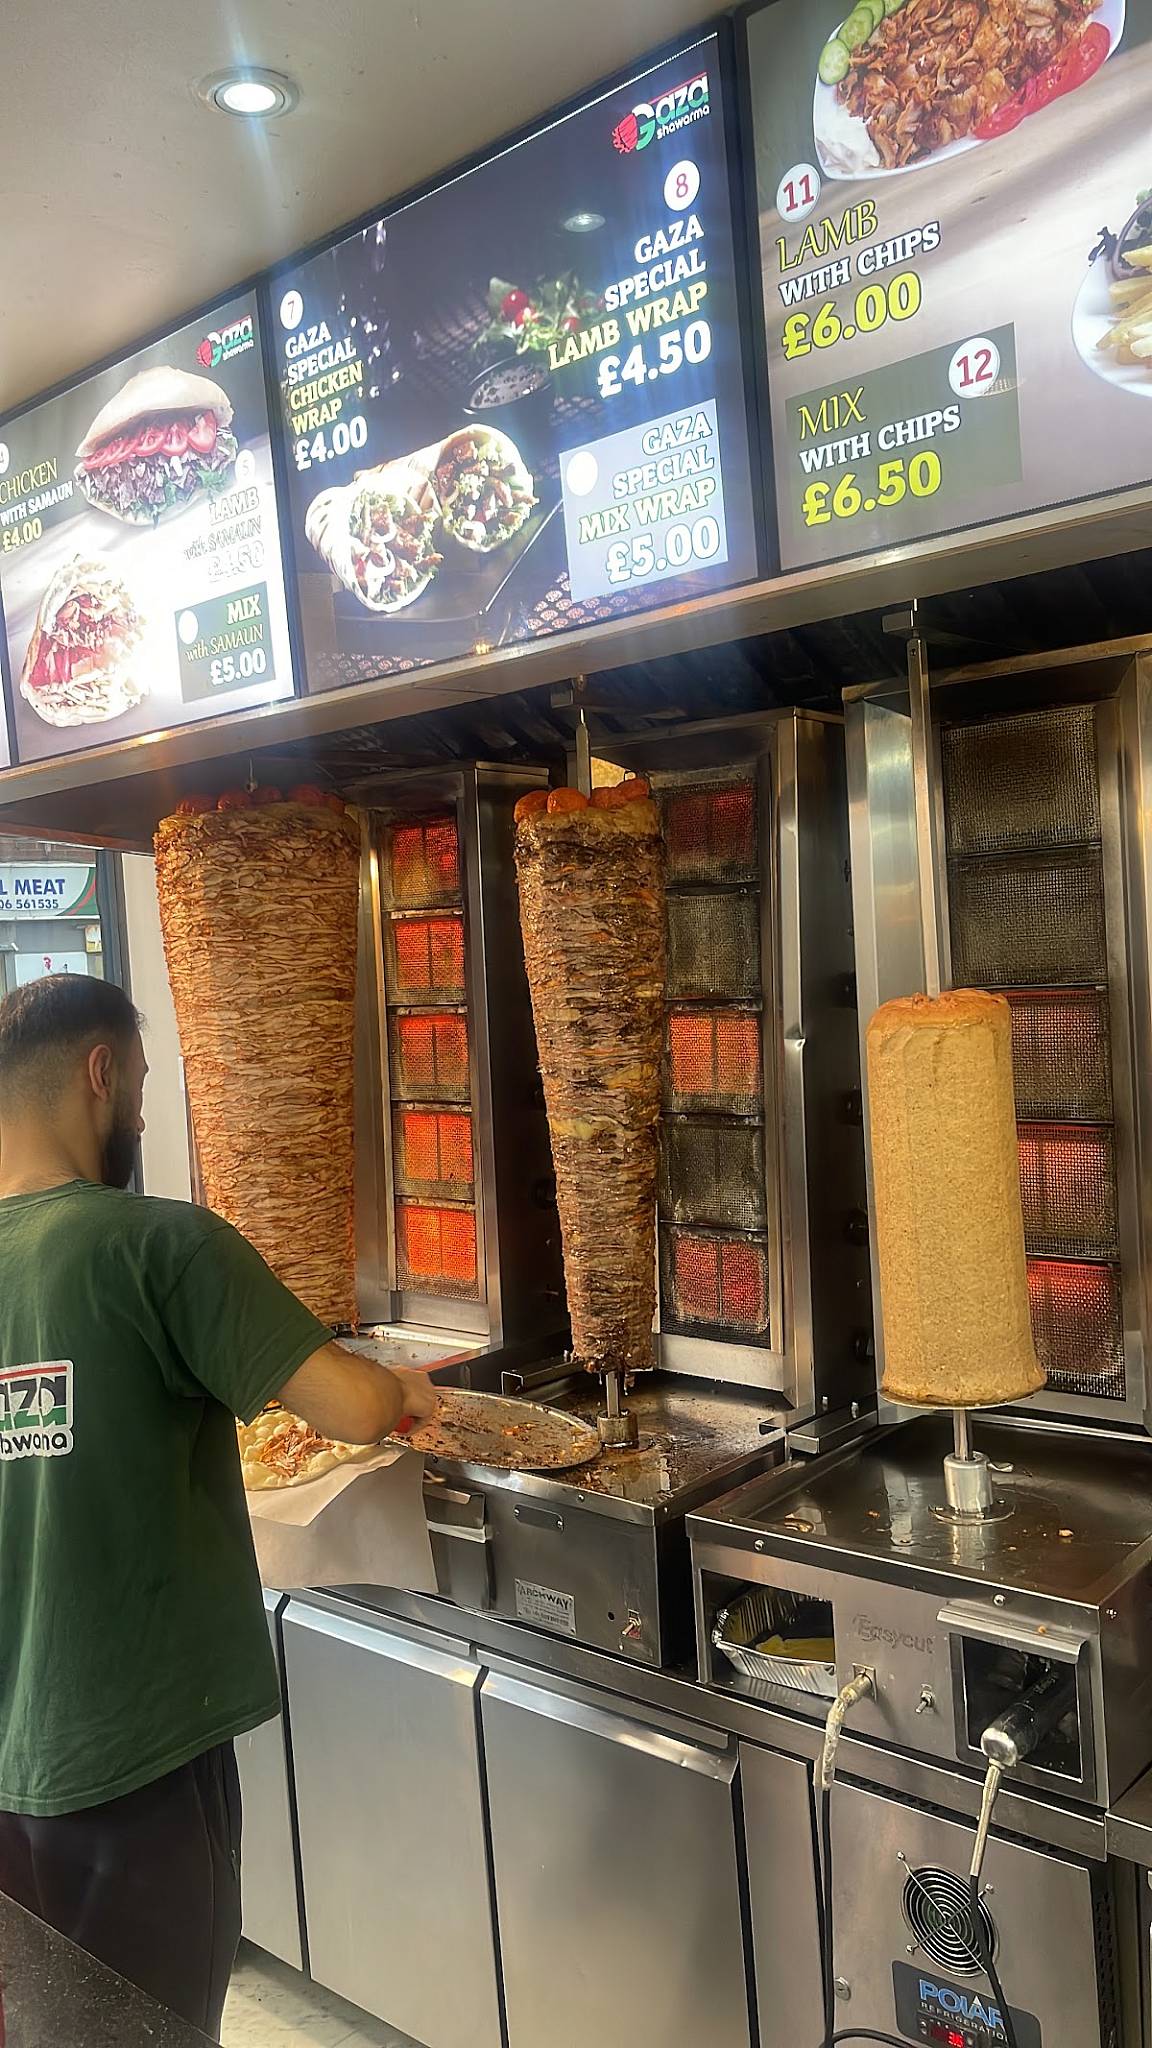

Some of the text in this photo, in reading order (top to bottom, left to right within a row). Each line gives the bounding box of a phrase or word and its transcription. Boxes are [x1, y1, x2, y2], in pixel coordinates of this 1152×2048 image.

[632, 76, 709, 151] Gaza
[657, 105, 710, 140] shawarma
[675, 173, 689, 198] 8
[783, 174, 815, 213] 11
[634, 214, 704, 264] GAZA
[776, 199, 879, 273] LAMB
[604, 248, 706, 312] SPECIAL
[778, 221, 941, 307] WITH CHIPS
[287, 301, 295, 321] 7
[548, 281, 708, 371] LAMB WRAP
[782, 271, 922, 361] £6.00
[207, 317, 253, 367] Gaza
[285, 321, 331, 359] GAZA
[288, 337, 357, 386] SPECIAL
[597, 320, 712, 399] £4.50
[290, 360, 364, 411] CHICKEN
[956, 348, 994, 388] 12
[292, 398, 343, 436] WRAP
[642, 411, 713, 456] GAZA
[798, 386, 867, 440] MIX
[295, 415, 368, 471] £4.00
[799, 403, 962, 474] WITH CHIPS
[0, 458, 58, 505] CHICKEN
[612, 444, 715, 499] SPECIAL
[802, 449, 942, 527] £6.50
[0, 481, 74, 527] WITH SAMAUN
[208, 487, 260, 526] LAMB
[579, 477, 716, 545] MIX WRAP
[2, 518, 42, 554] £4.00
[606, 516, 721, 585] £5.00
[226, 593, 262, 625] MIX
[184, 623, 263, 662] with SAMAUN
[210, 647, 266, 687] £5.00
[14, 878, 66, 895] MEAT
[16, 899, 59, 910] 561535
[519, 1585, 569, 1611] ARCHWAY
